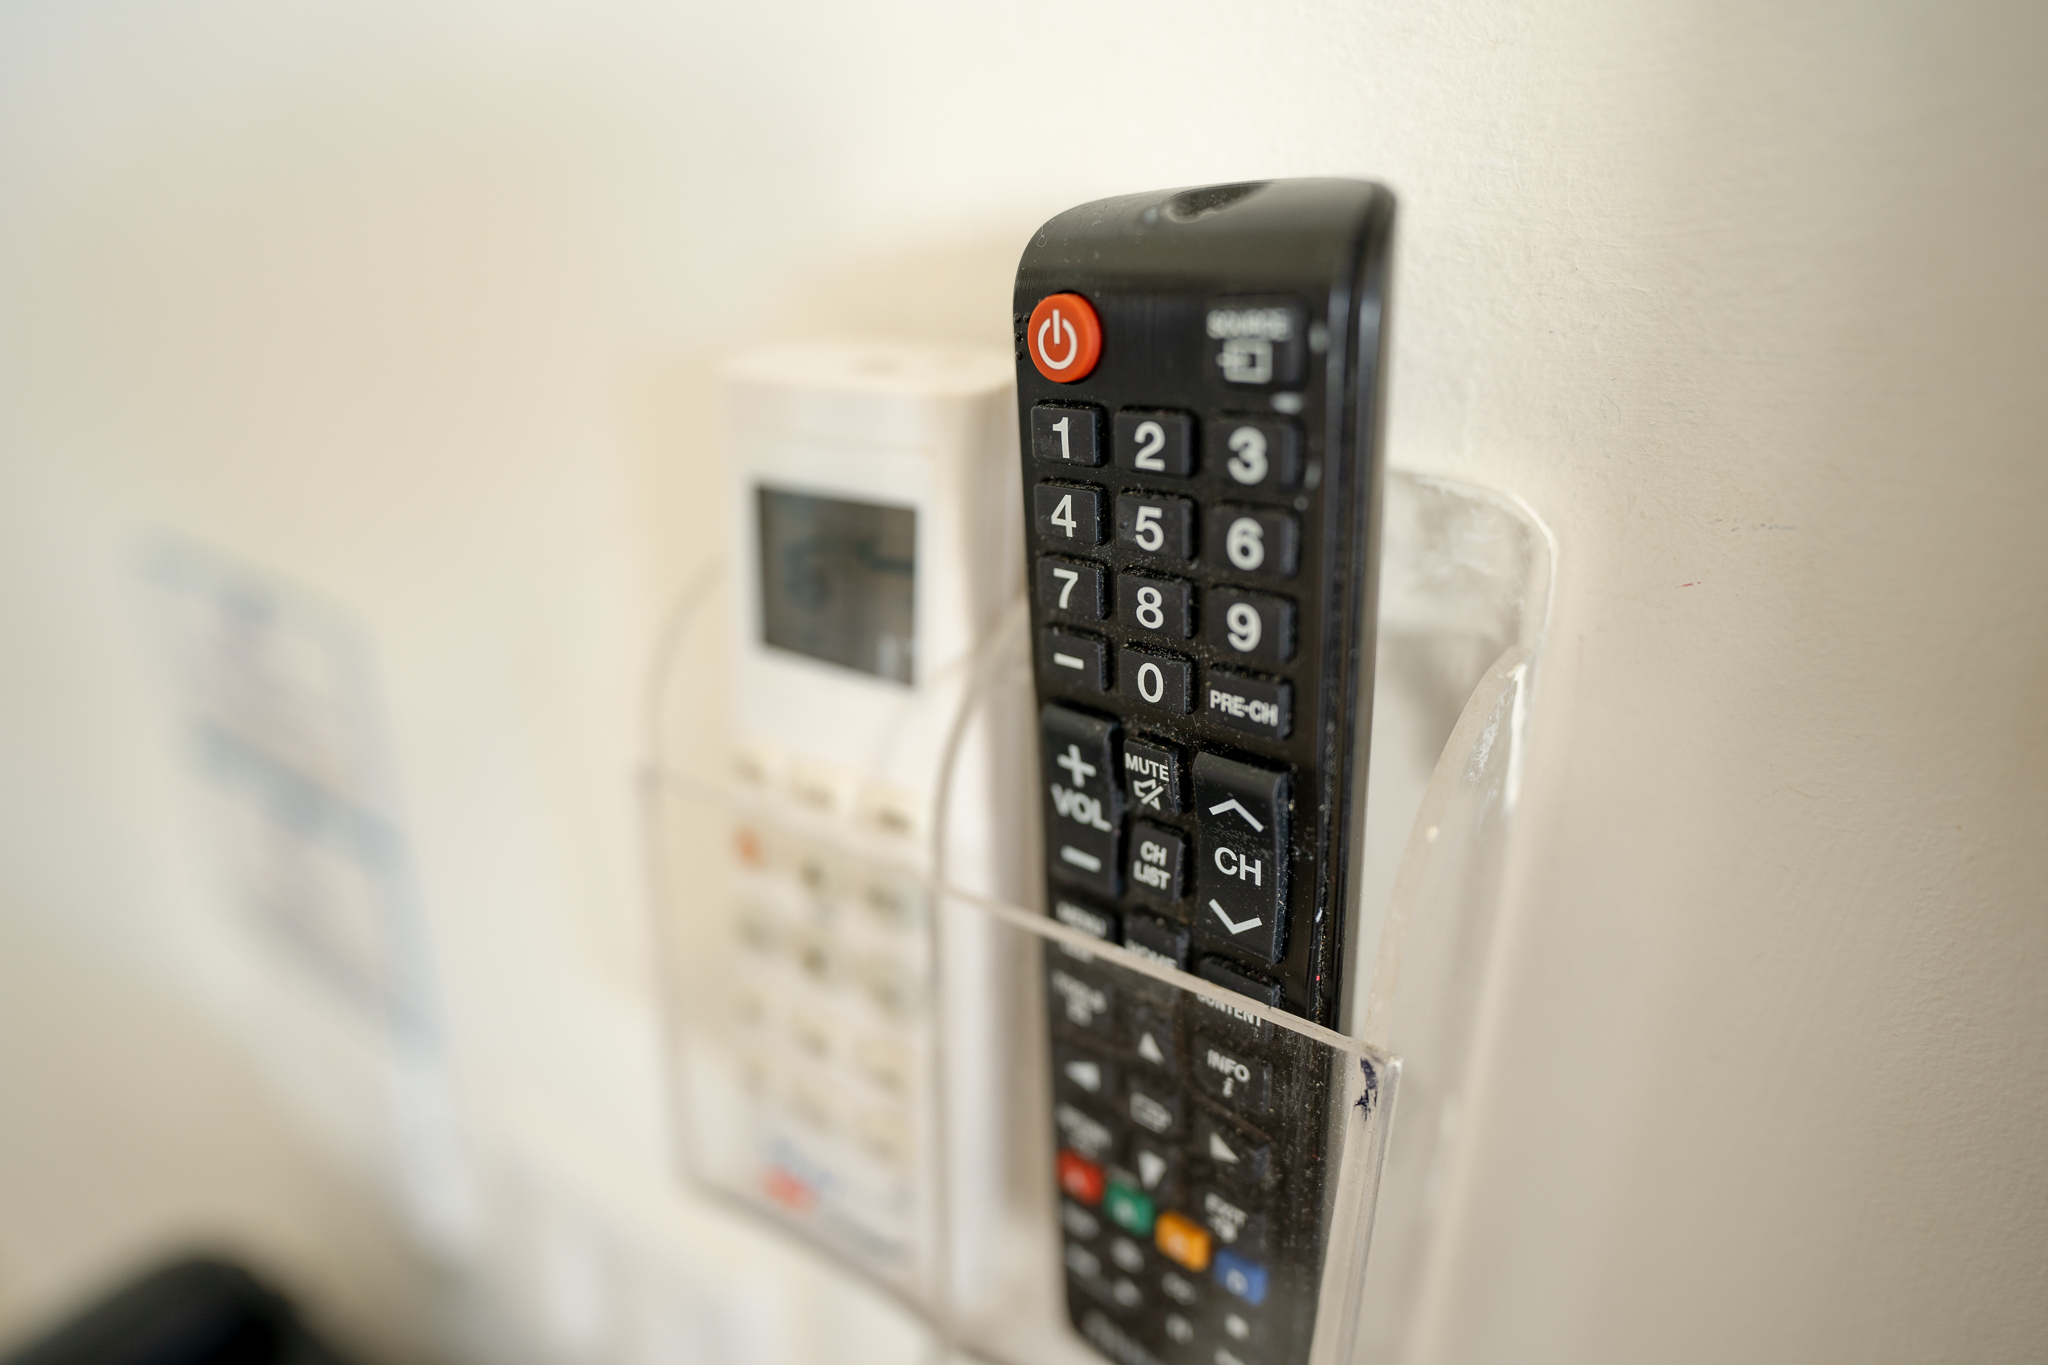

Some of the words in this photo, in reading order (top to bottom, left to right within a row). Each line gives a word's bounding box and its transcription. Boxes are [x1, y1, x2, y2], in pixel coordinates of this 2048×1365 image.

[1053, 417, 1070, 458] 1
[1135, 422, 1164, 470] 2
[1229, 427, 1267, 483] 3
[1051, 495, 1076, 537] 4
[1135, 506, 1163, 551] 5
[1227, 518, 1263, 569] 6
[1054, 568, 1078, 608] 7
[1136, 587, 1163, 629] 8
[1227, 603, 1261, 651] 9
[1138, 663, 1163, 702] 0
[1210, 690, 1278, 726] PRE-CH
[1125, 753, 1169, 783] MUTE
[1052, 782, 1112, 831] VOL
[1140, 841, 1167, 867] CH
[1215, 847, 1261, 886] CH
[1133, 860, 1171, 890] LIST
[1207, 1050, 1250, 1084] INFO
